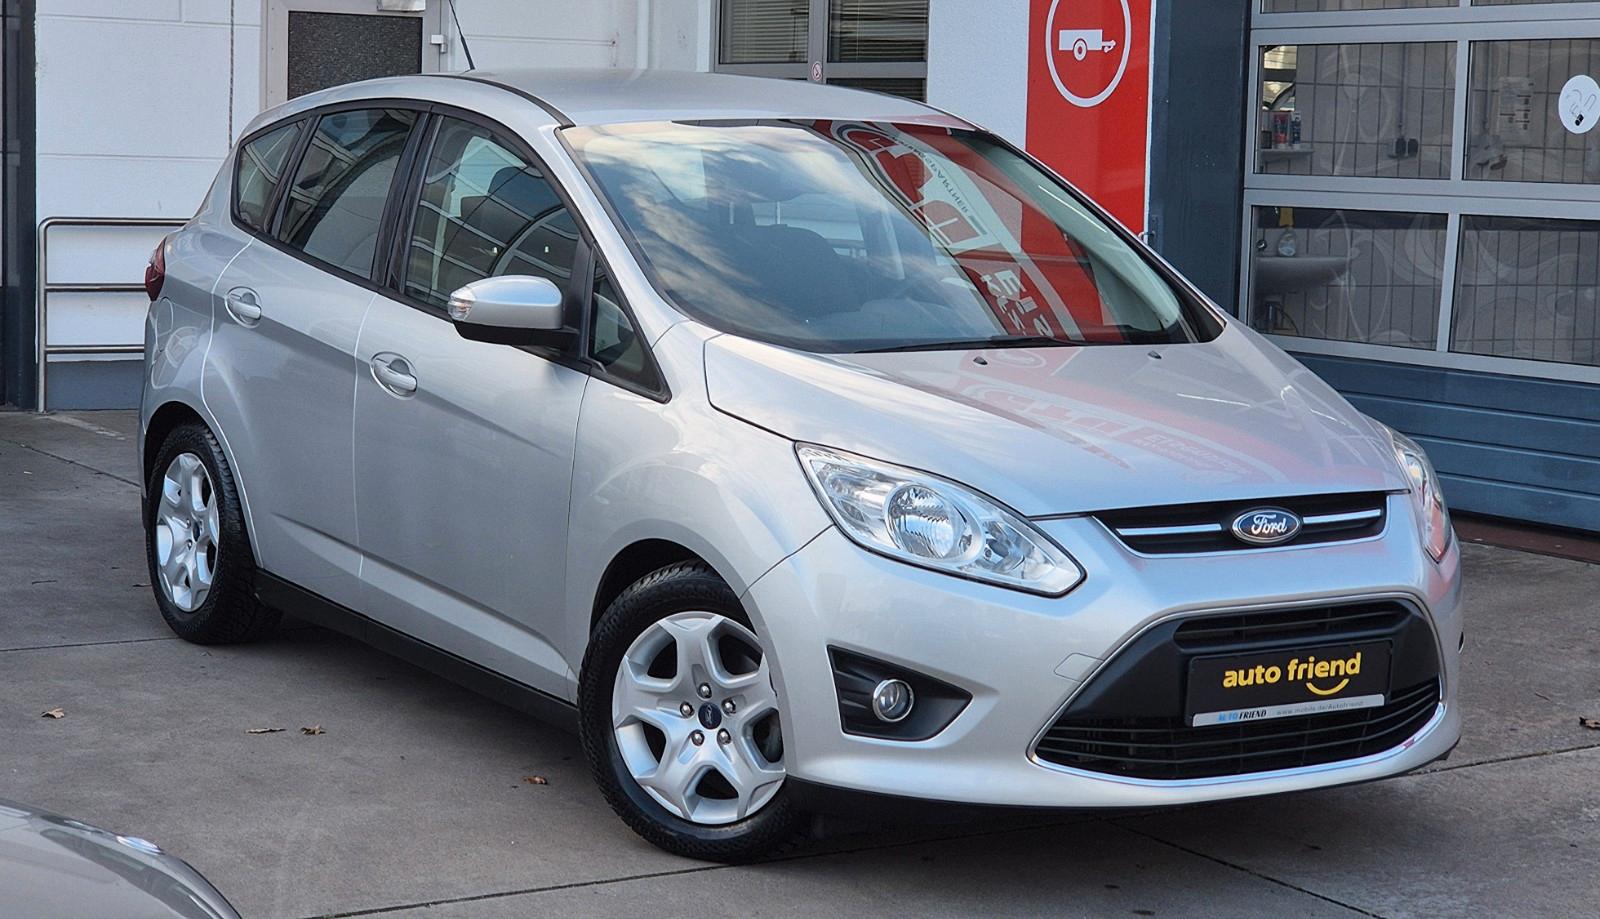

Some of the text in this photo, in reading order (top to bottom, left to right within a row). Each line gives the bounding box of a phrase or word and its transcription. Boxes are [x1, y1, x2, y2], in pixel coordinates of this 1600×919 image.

[1251, 514, 1287, 535] Ford
[1222, 652, 1361, 688] auto friend
